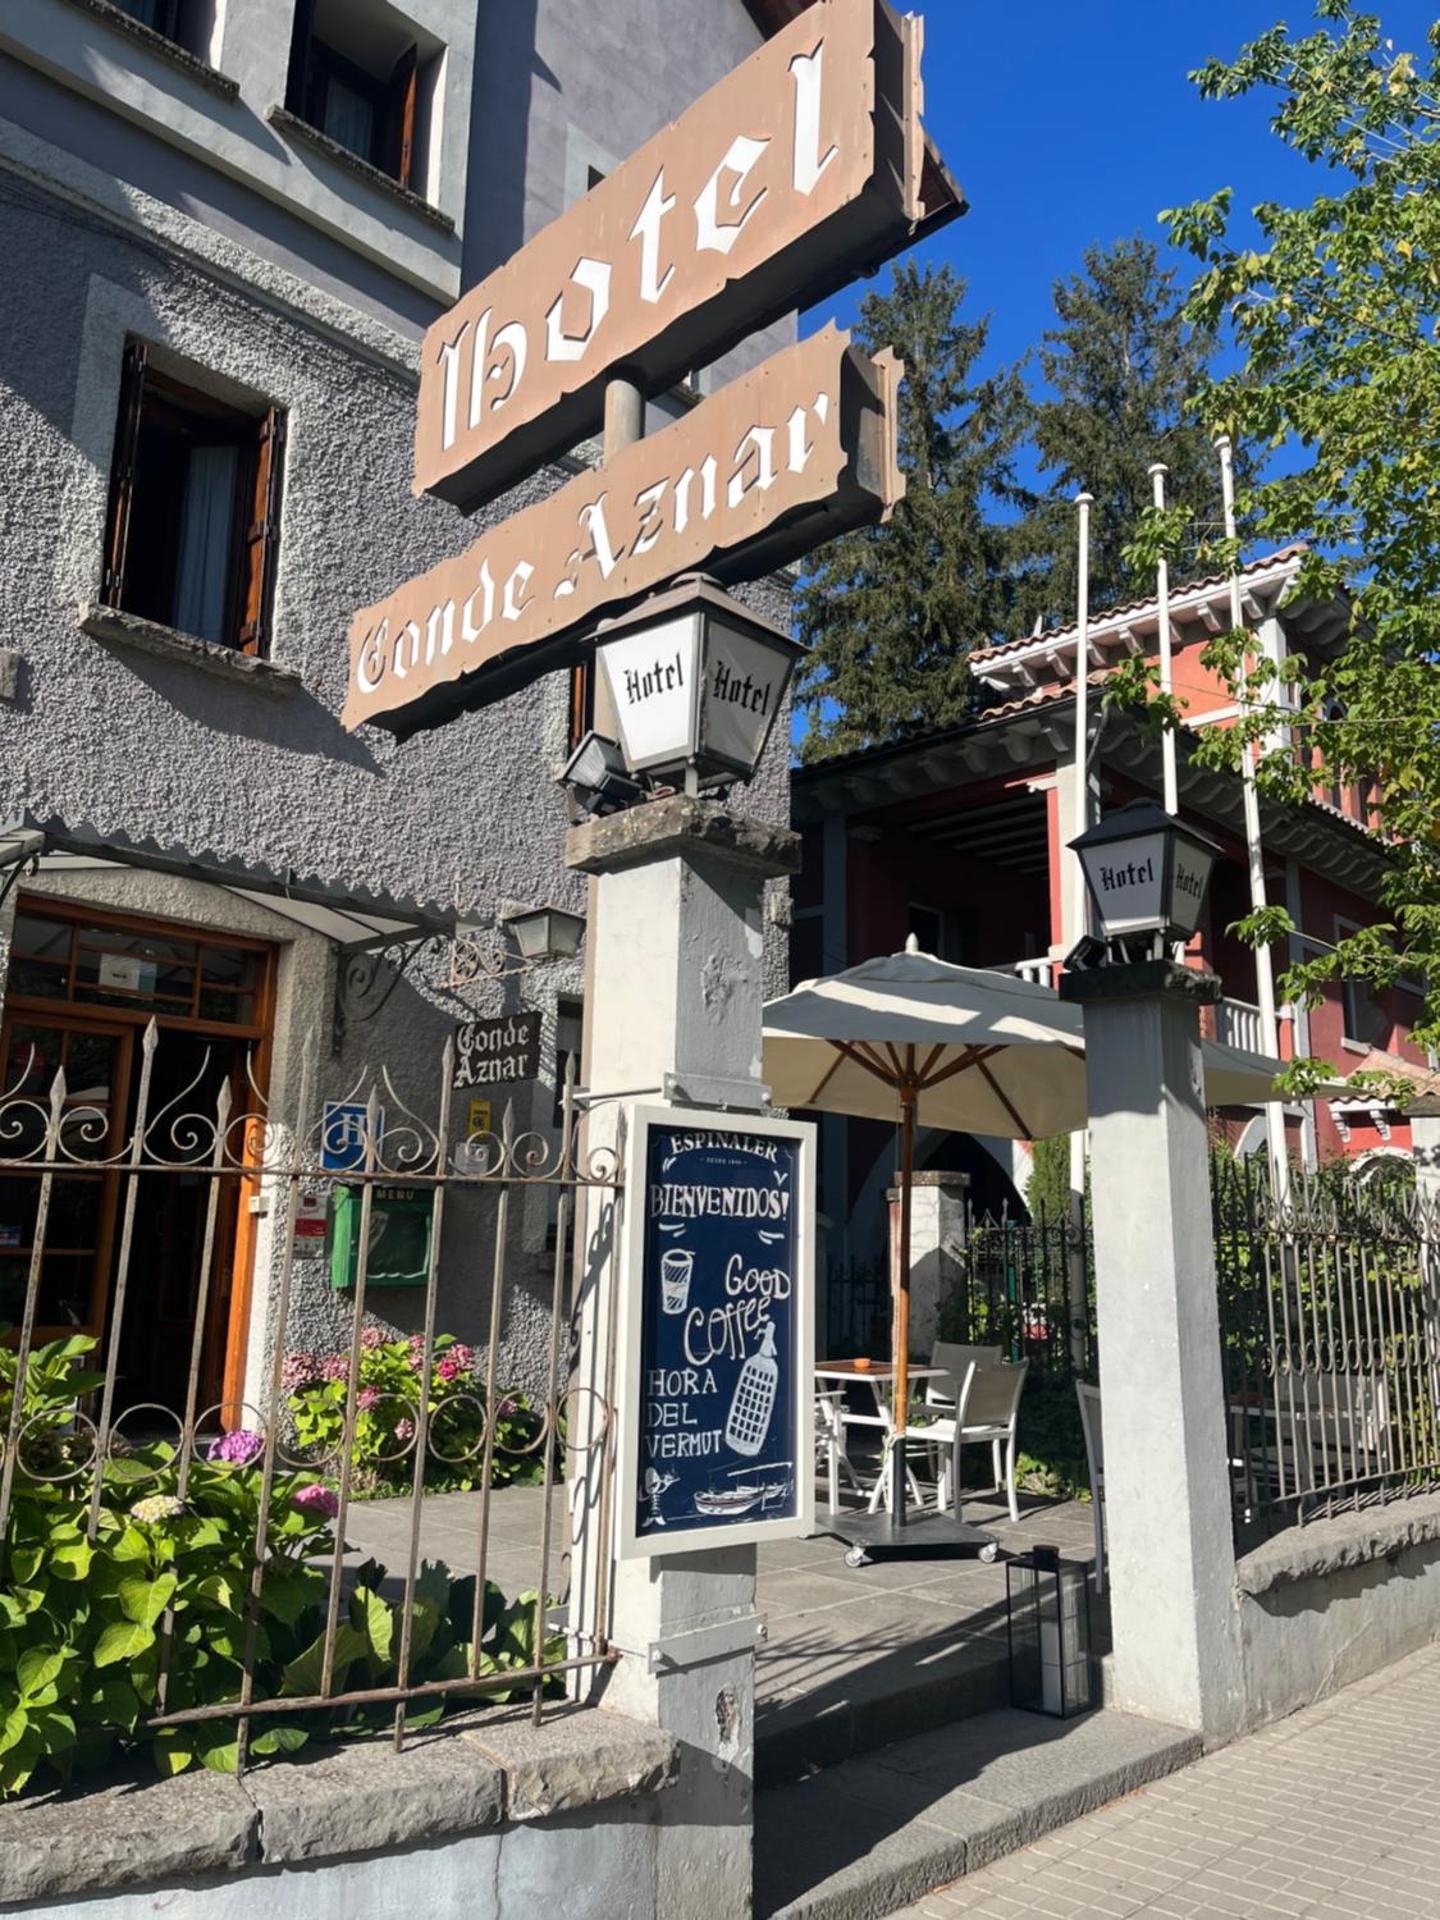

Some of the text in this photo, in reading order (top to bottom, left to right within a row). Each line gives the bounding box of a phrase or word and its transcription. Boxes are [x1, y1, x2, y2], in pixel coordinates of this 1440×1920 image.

[437, 37, 840, 452] Hotel
[356, 392, 830, 695] Conde Aznar
[624, 652, 685, 704] Hotel
[712, 659, 771, 717] Hotel
[1100, 857, 1154, 892] Hotel
[1175, 863, 1204, 900] Hotel
[456, 1016, 529, 1057] Conde
[452, 1054, 528, 1089] Aznar
[670, 1131, 778, 1164] ESPINALER
[376, 1189, 415, 1201] MENU
[650, 1183, 791, 1221] BIENVENIDOS!
[649, 1366, 719, 1398] HORA
[648, 1402, 698, 1428] DEL
[645, 1429, 723, 1458] VERMUT
